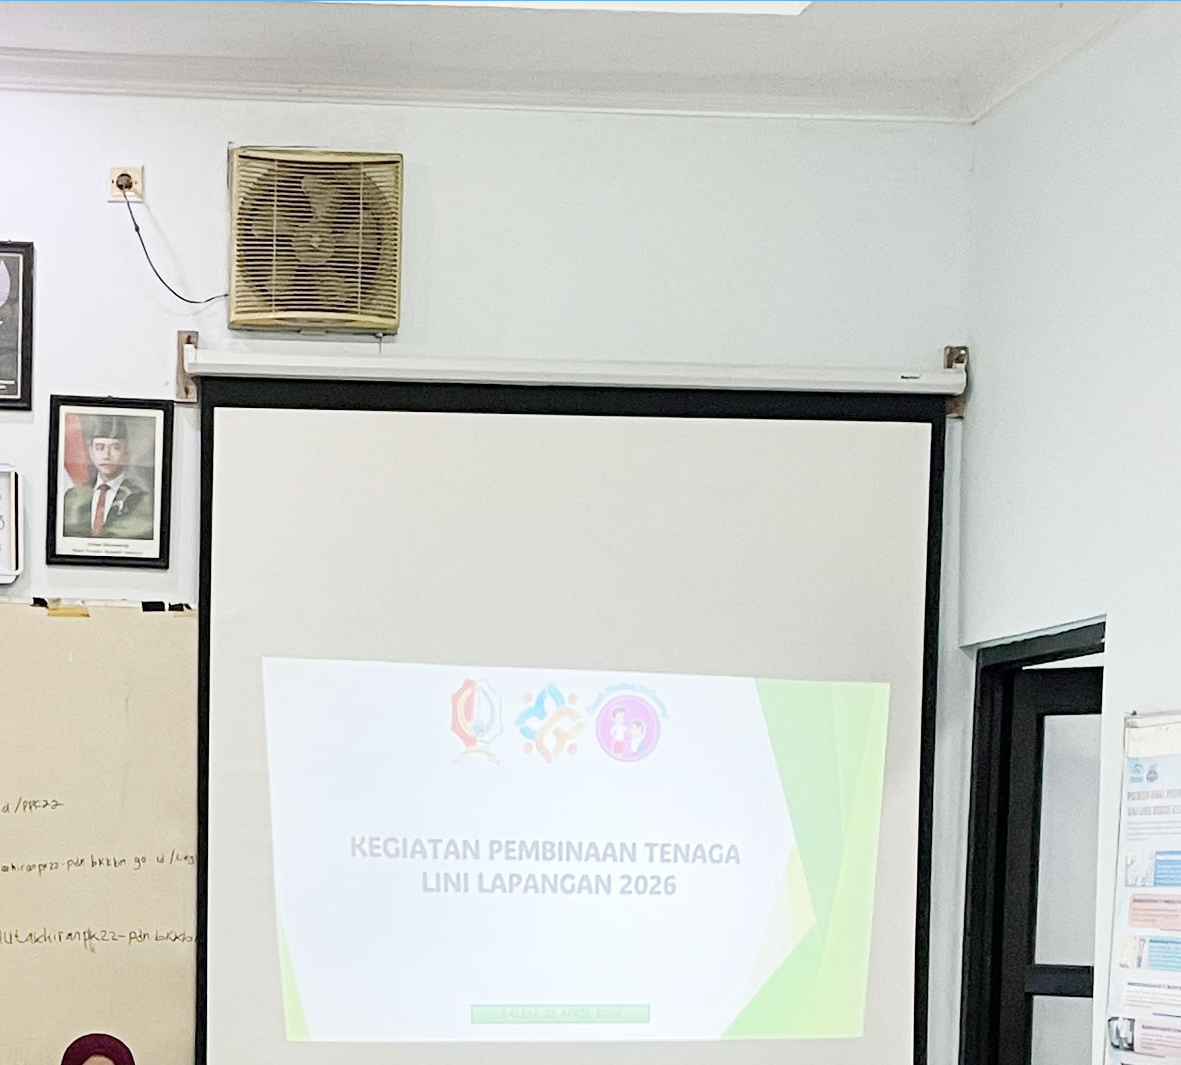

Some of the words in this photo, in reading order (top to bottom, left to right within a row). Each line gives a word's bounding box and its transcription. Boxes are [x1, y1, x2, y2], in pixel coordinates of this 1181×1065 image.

[350, 835, 481, 861] KEGIATAN
[488, 838, 638, 864] PEMBINAAN
[644, 841, 741, 866] TENAGA
[421, 871, 470, 894] LINI
[477, 872, 612, 896] LAPANGAN
[619, 874, 678, 896] 2026
